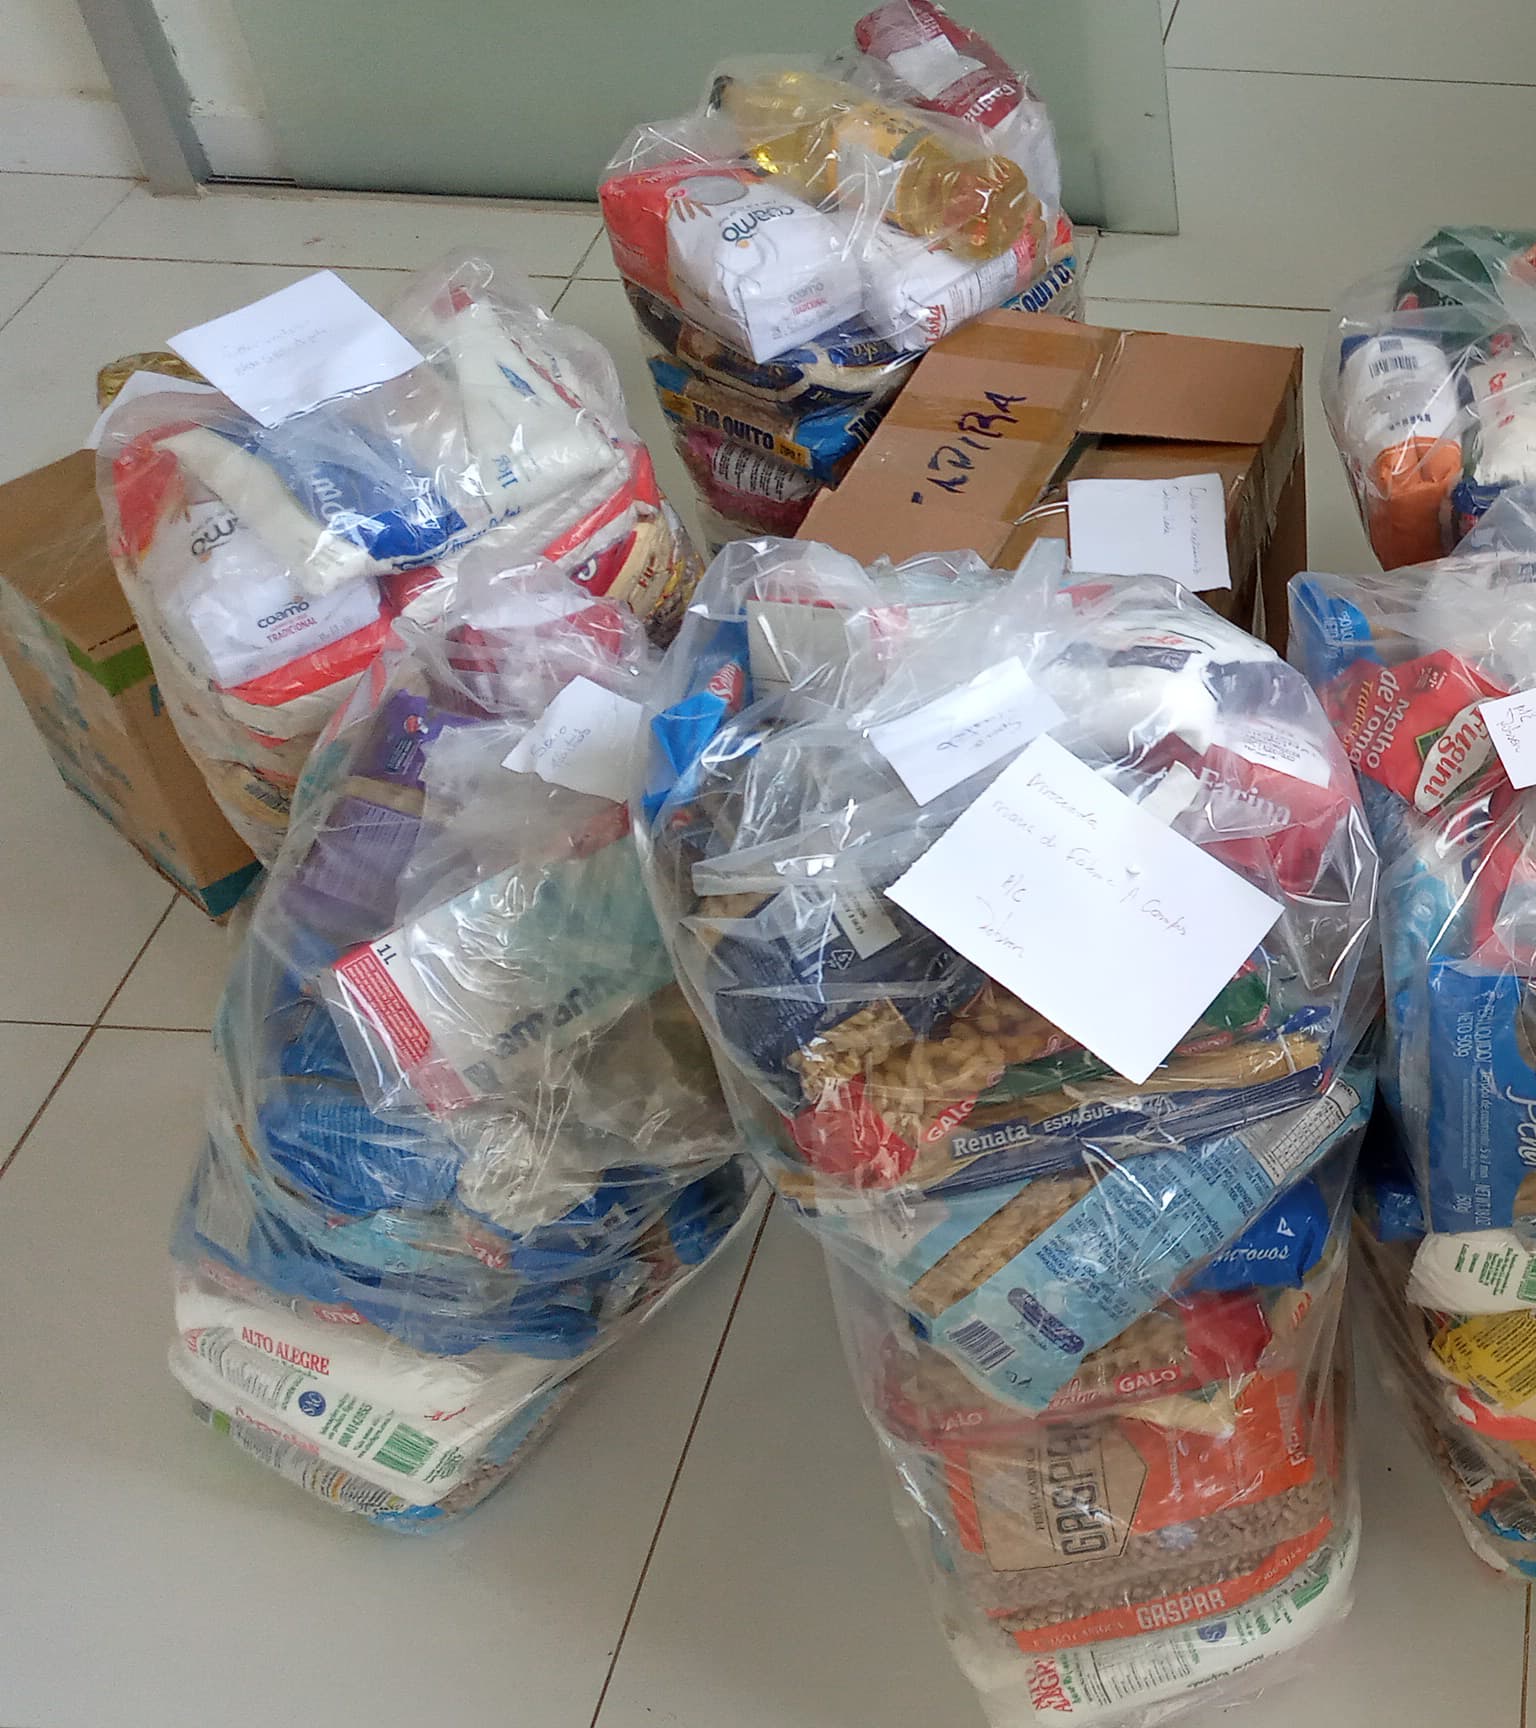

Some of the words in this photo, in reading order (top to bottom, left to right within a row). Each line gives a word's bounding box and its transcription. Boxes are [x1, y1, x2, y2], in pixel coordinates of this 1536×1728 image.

[693, 401, 722, 428] TIO
[722, 414, 775, 451] QUITO
[257, 600, 310, 630] coamo
[266, 615, 318, 645] TRADICIONAL
[1423, 705, 1489, 799] Fugini
[376, 942, 398, 966] 1L
[926, 1098, 977, 1143] GALO
[951, 1122, 1031, 1158] Renata
[241, 1325, 275, 1355] ALTO
[275, 1341, 331, 1377] ALEGRE
[1118, 1368, 1178, 1393] GALO
[1135, 1588, 1226, 1631] GASPAR
